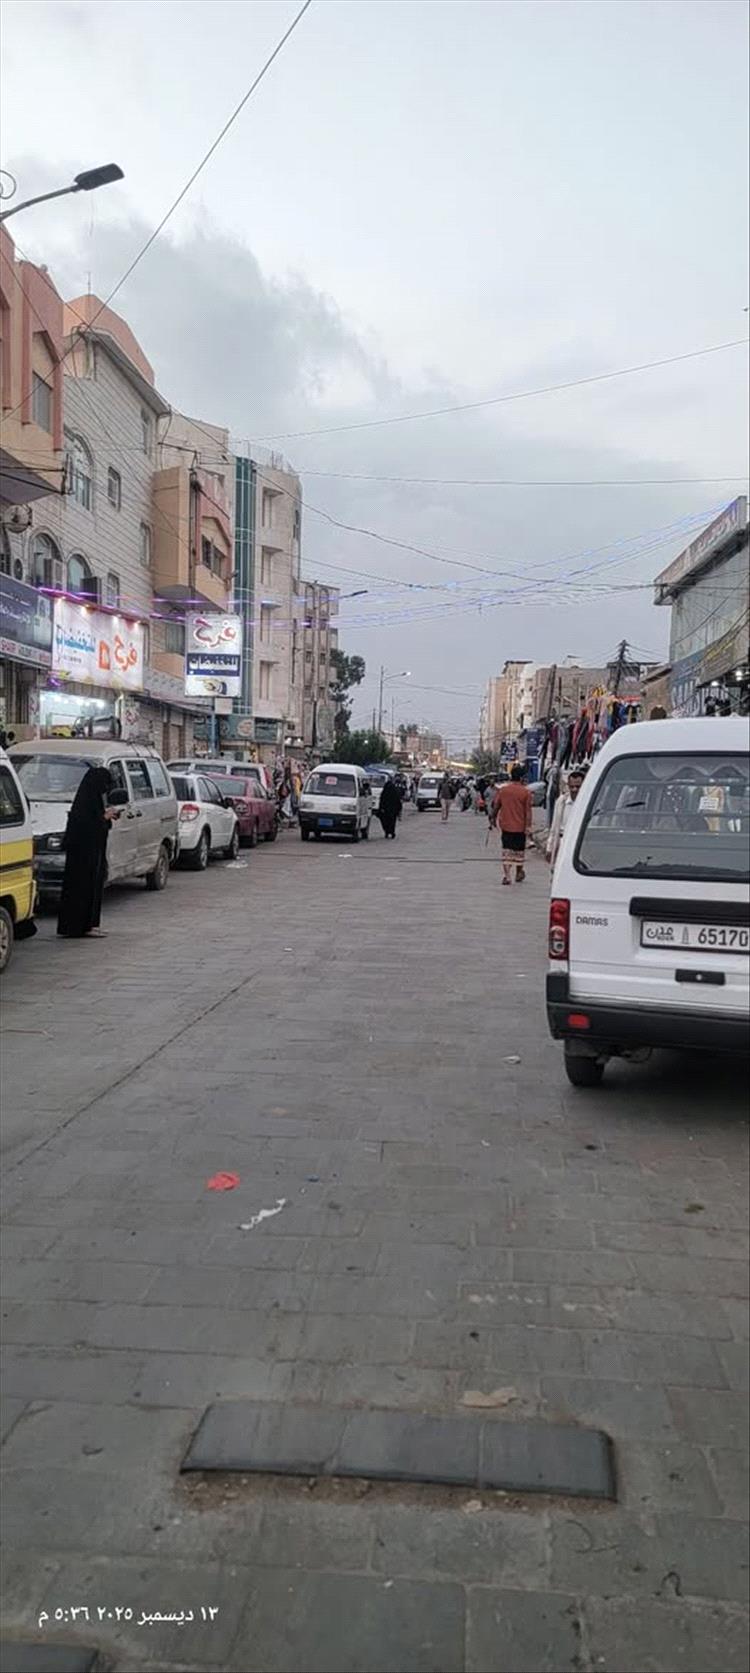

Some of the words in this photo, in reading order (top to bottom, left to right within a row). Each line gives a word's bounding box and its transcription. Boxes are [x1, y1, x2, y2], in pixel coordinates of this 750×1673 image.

[193, 617, 236, 648] فرح
[113, 634, 138, 671] فرح
[189, 655, 238, 675] للتخفيضات
[575, 915, 609, 927] DAMAS
[697, 927, 749, 947] 65170
